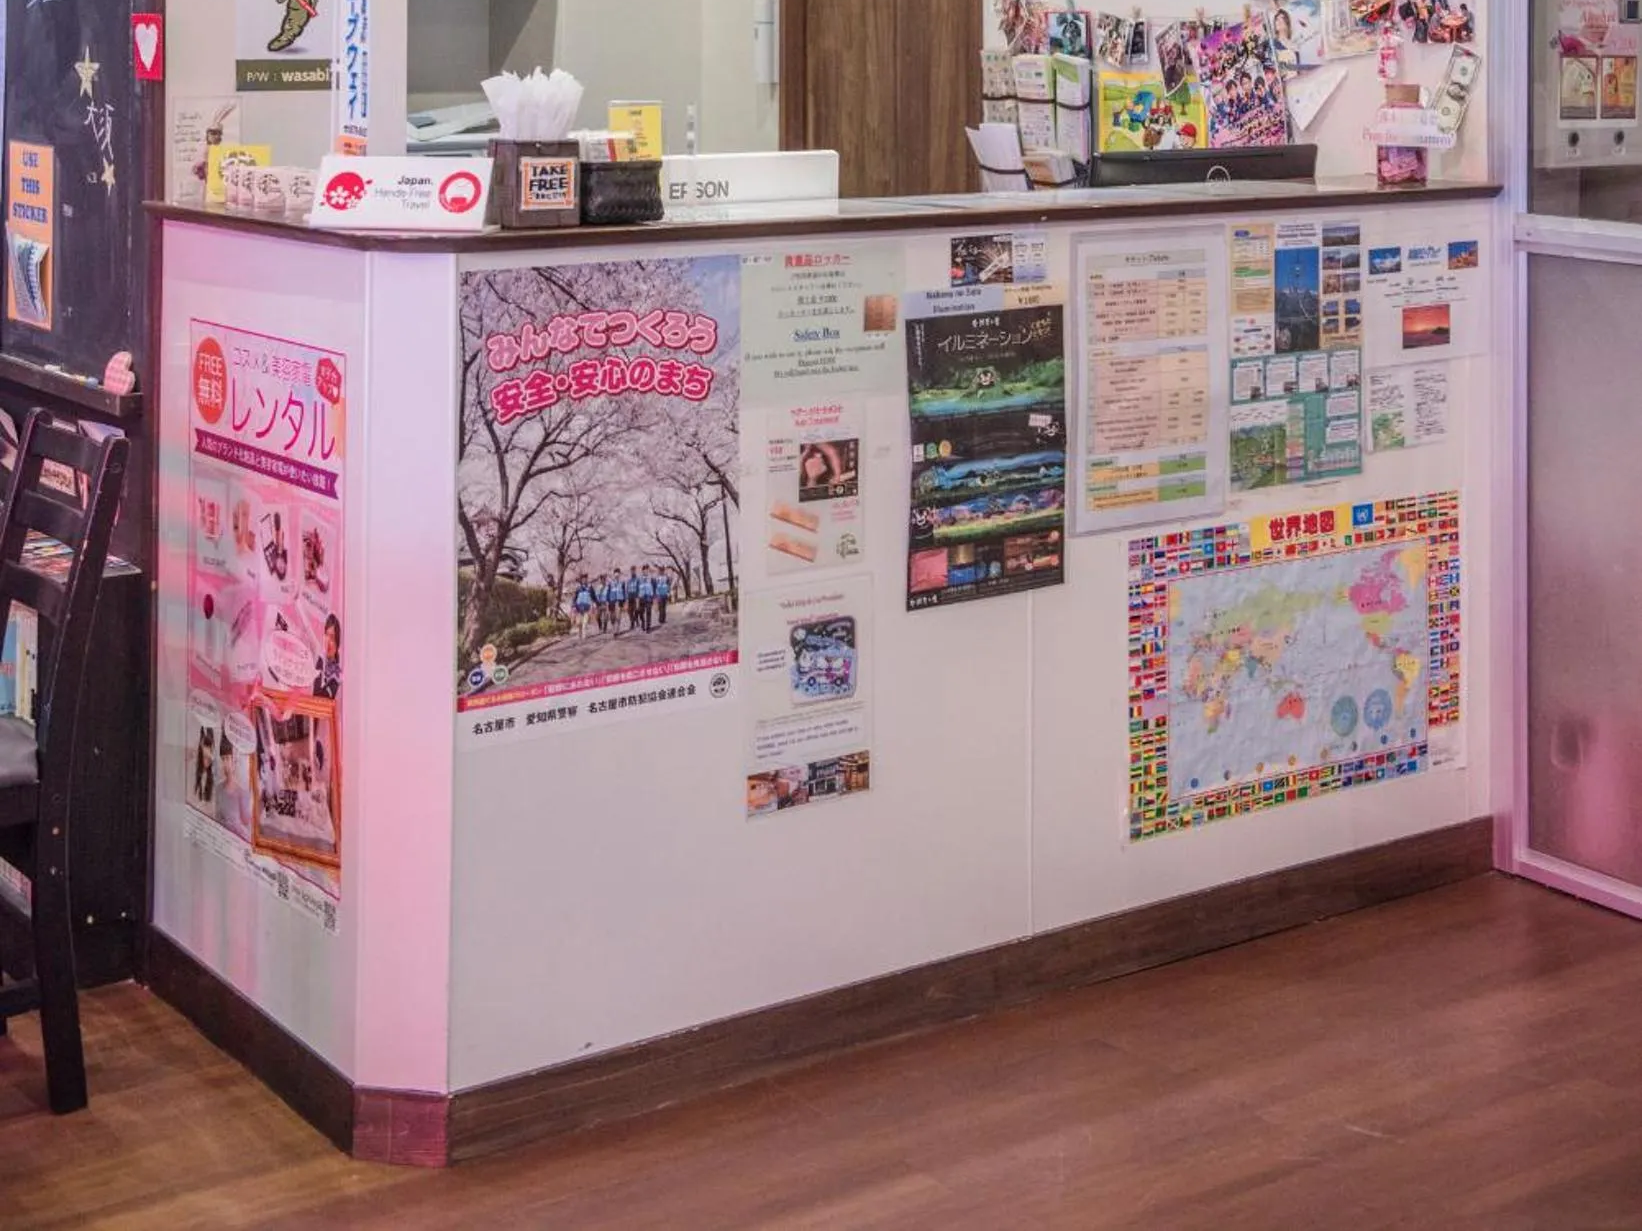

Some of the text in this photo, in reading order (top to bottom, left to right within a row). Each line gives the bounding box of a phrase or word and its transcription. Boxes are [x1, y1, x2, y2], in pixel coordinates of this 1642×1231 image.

[21, 177, 40, 195] THIS
[529, 177, 569, 192] FREE
[531, 164, 568, 177] TAKE
[12, 201, 48, 224] STICKER
[486, 309, 718, 374] みんなでつくろう
[490, 355, 714, 426] 安全・安心のまち
[231, 377, 336, 461] レンタル
[1268, 509, 1336, 542] 世界地図
[472, 716, 516, 736] 名古屋市
[525, 705, 579, 727] 愛知県警察
